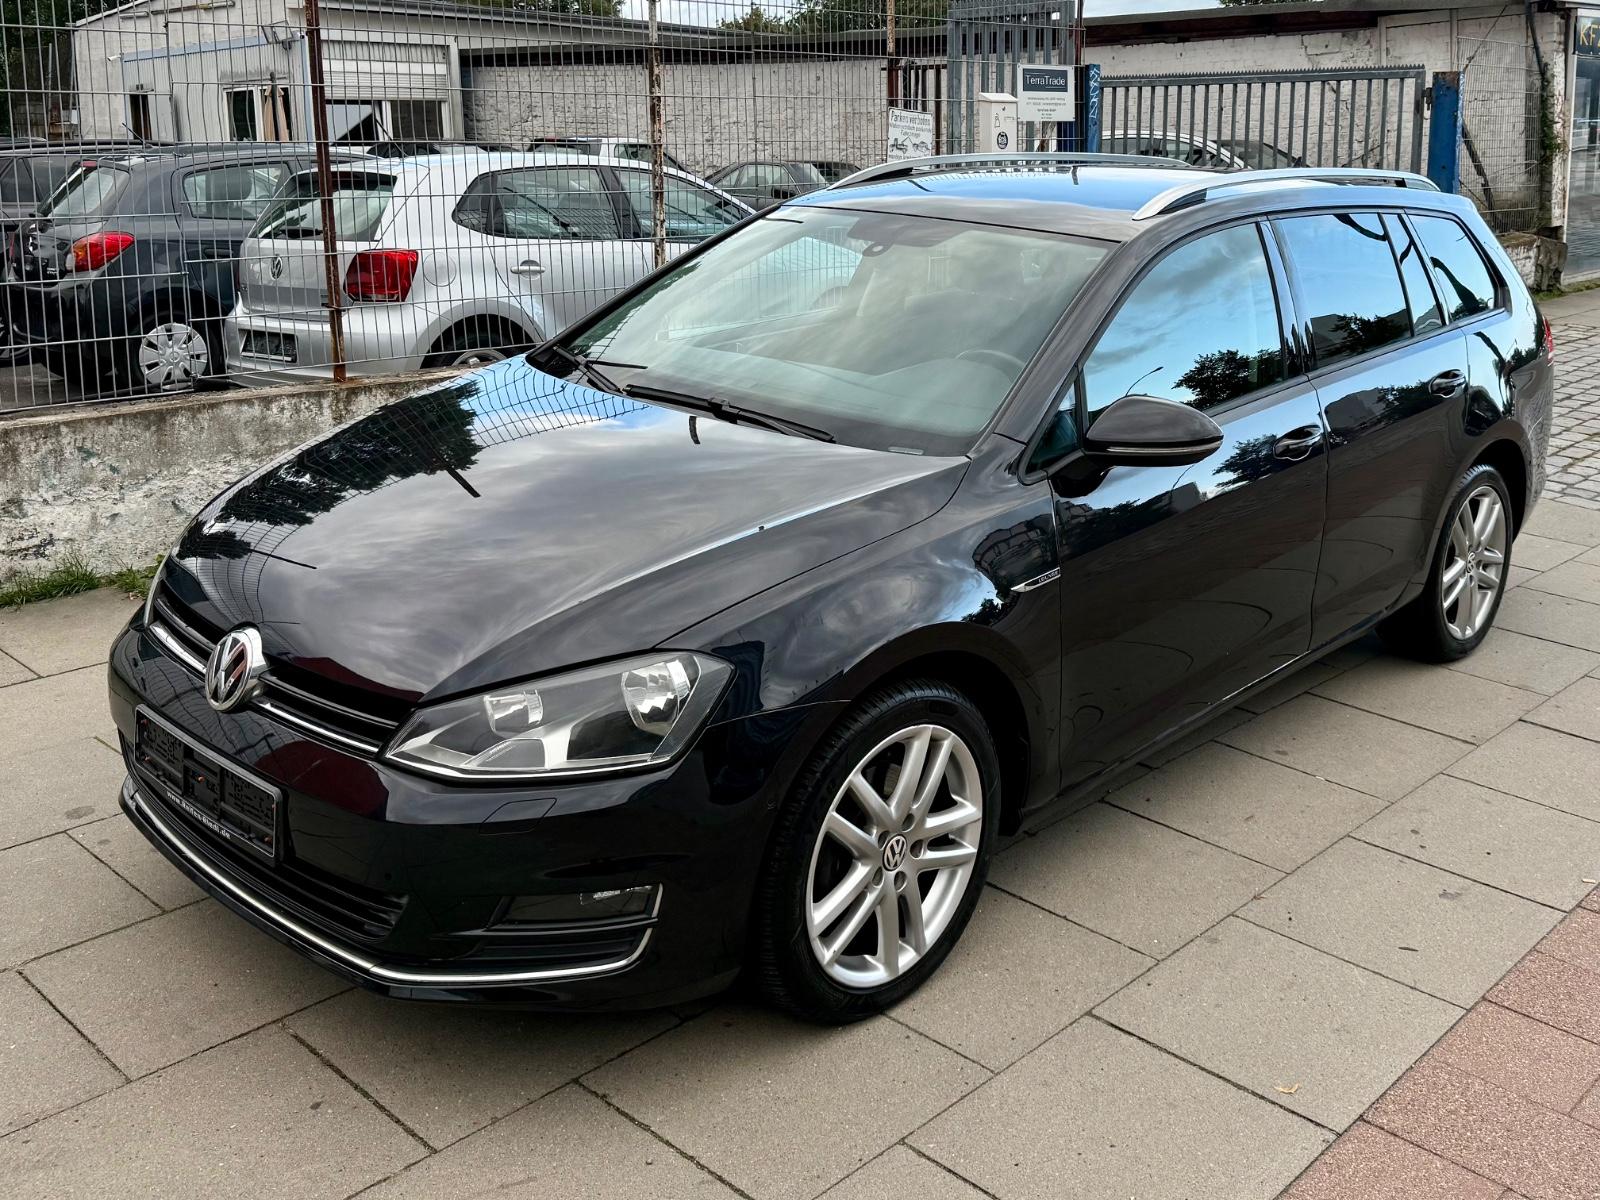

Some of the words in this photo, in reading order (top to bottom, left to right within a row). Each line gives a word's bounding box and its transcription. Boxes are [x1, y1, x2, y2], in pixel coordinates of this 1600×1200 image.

[1580, 24, 1600, 47] KF
[1025, 75, 1065, 86] TerraTrade
[891, 110, 908, 123] Parken
[884, 836, 906, 870] VW
